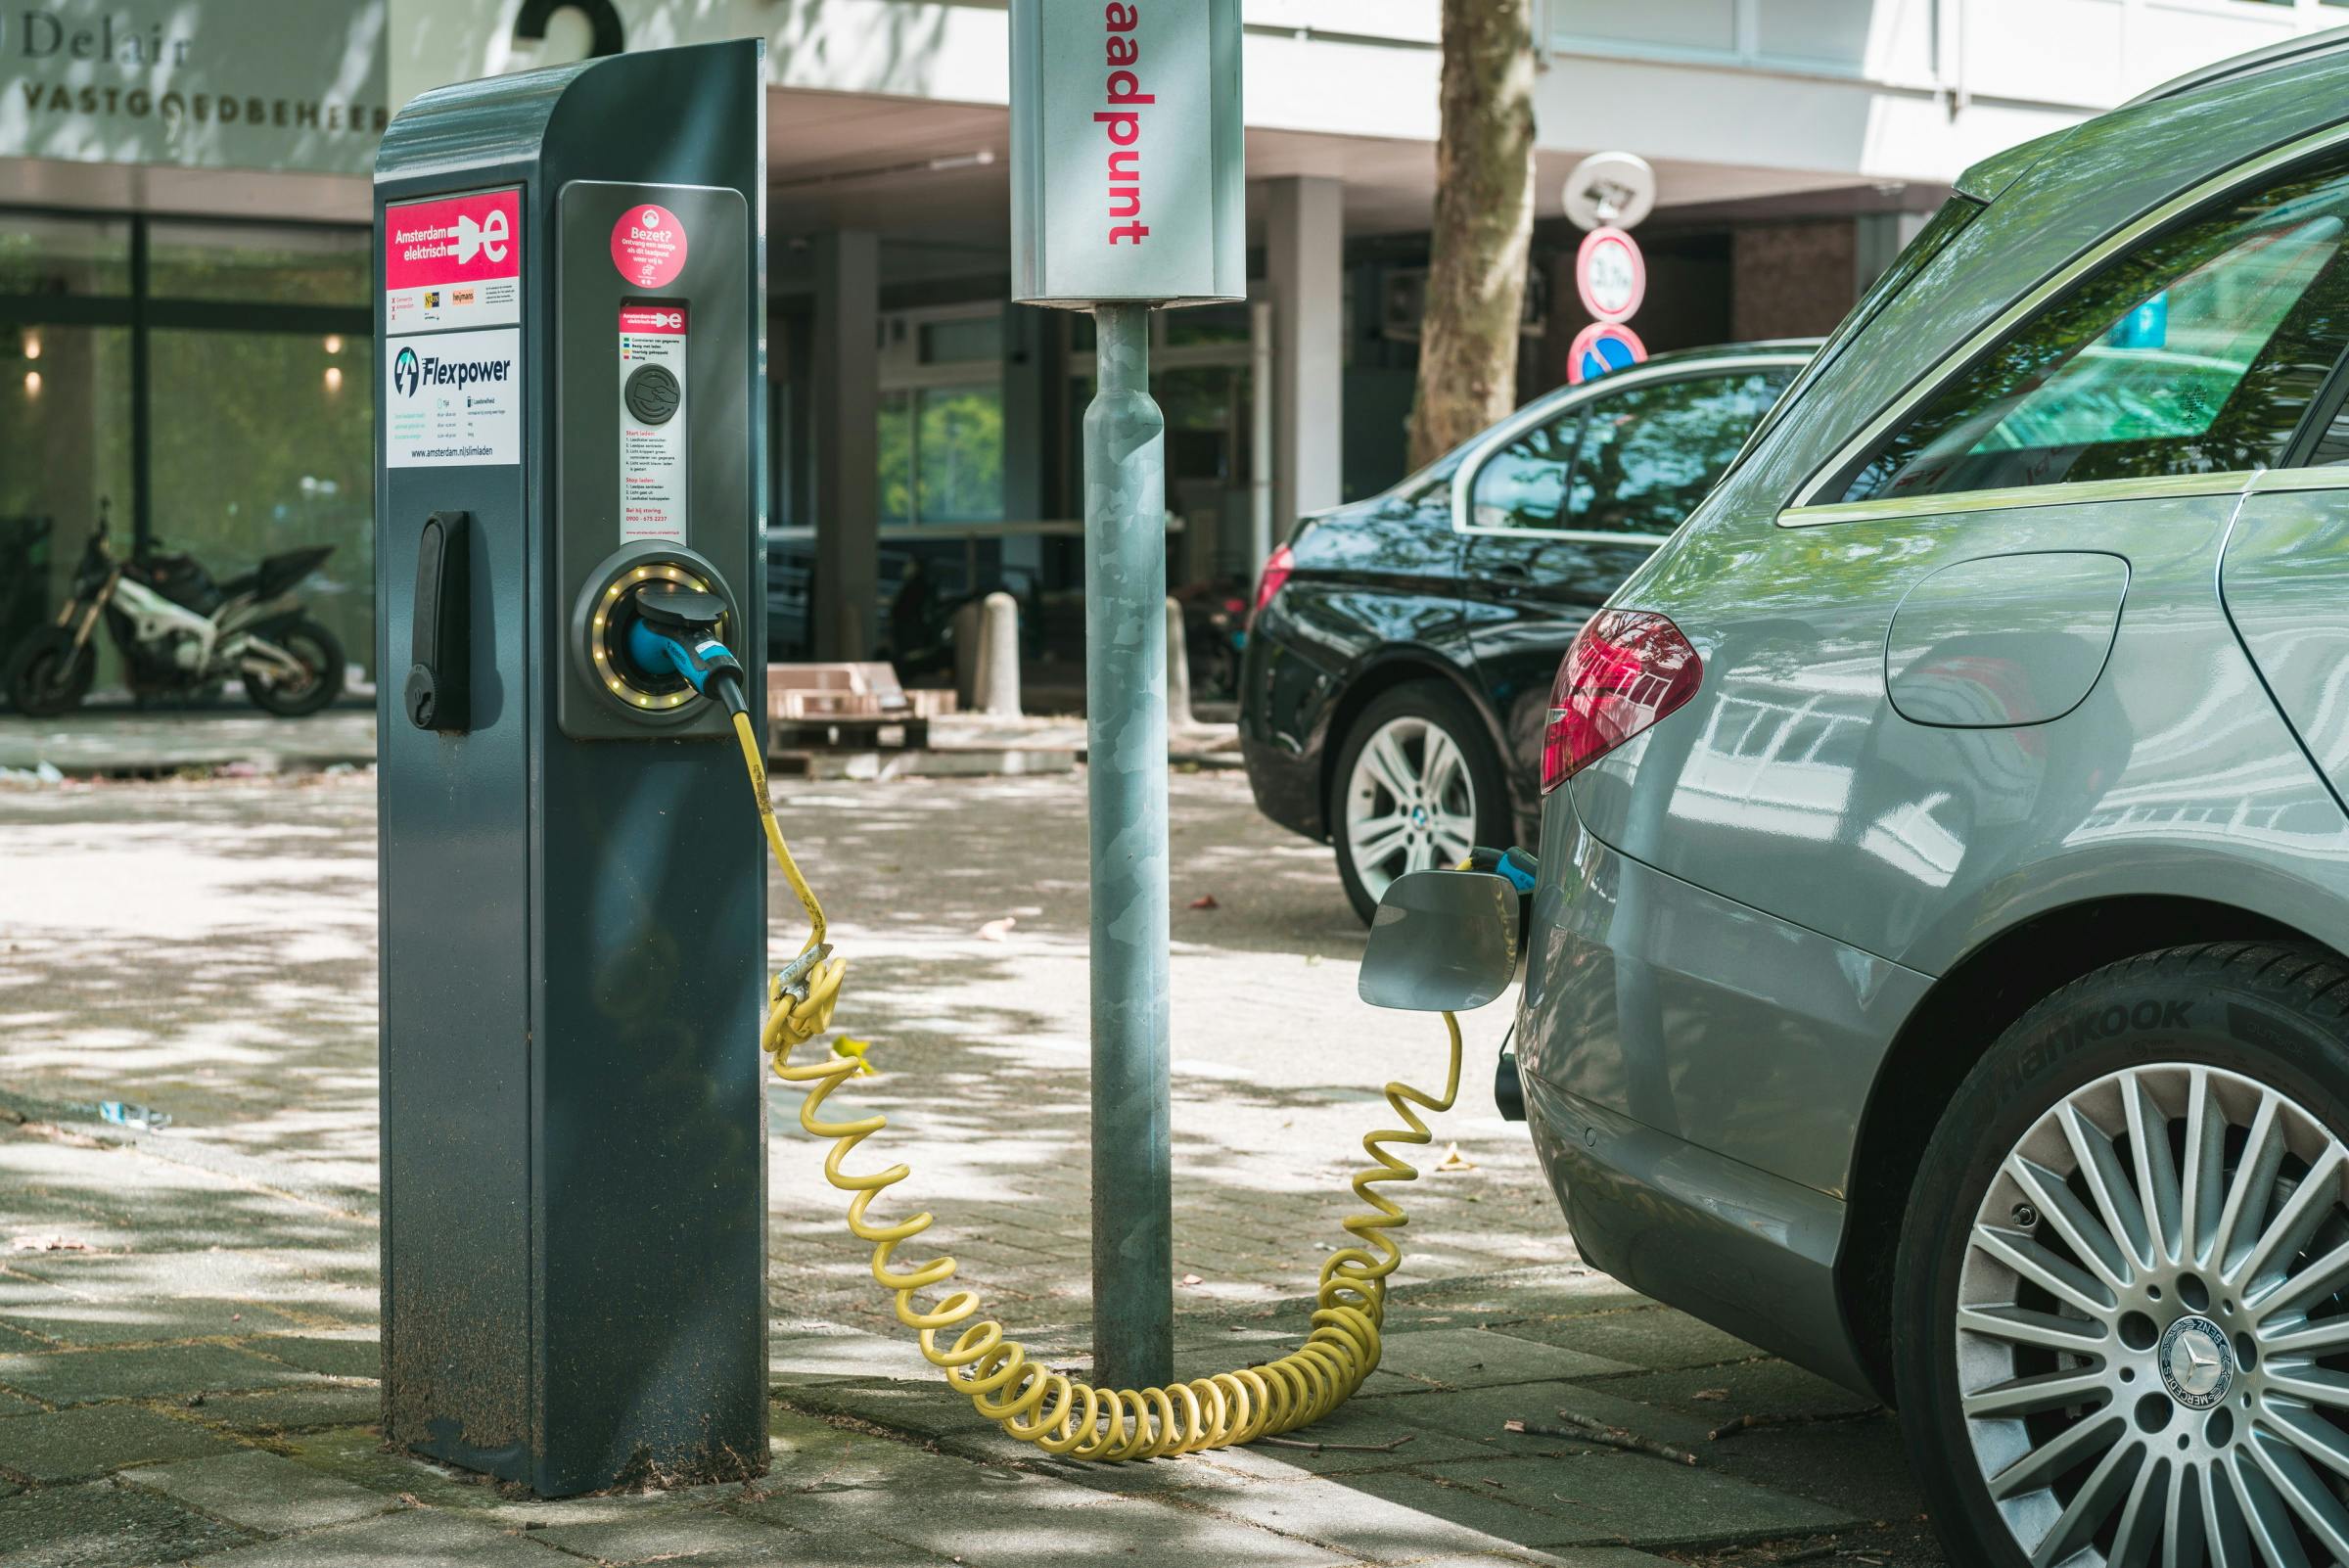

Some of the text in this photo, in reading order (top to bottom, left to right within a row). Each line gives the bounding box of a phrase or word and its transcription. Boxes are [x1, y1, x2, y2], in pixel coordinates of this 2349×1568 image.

[20, 10, 192, 69] Delair
[22, 83, 389, 134] VASTGOEDBEHEER
[395, 225, 446, 244] Amsterdam
[622, 238, 645, 248] Ontvang
[631, 227, 671, 242] Bezet?
[403, 242, 446, 260] elektrisch
[453, 293, 474, 302] heijmans
[422, 357, 510, 391] Flexpower
[411, 445, 492, 458] www.amsterdam.nl/slimladen
[2196, 1319, 2223, 1345] BENZ
[2163, 1366, 2209, 1406] MERCEDES
